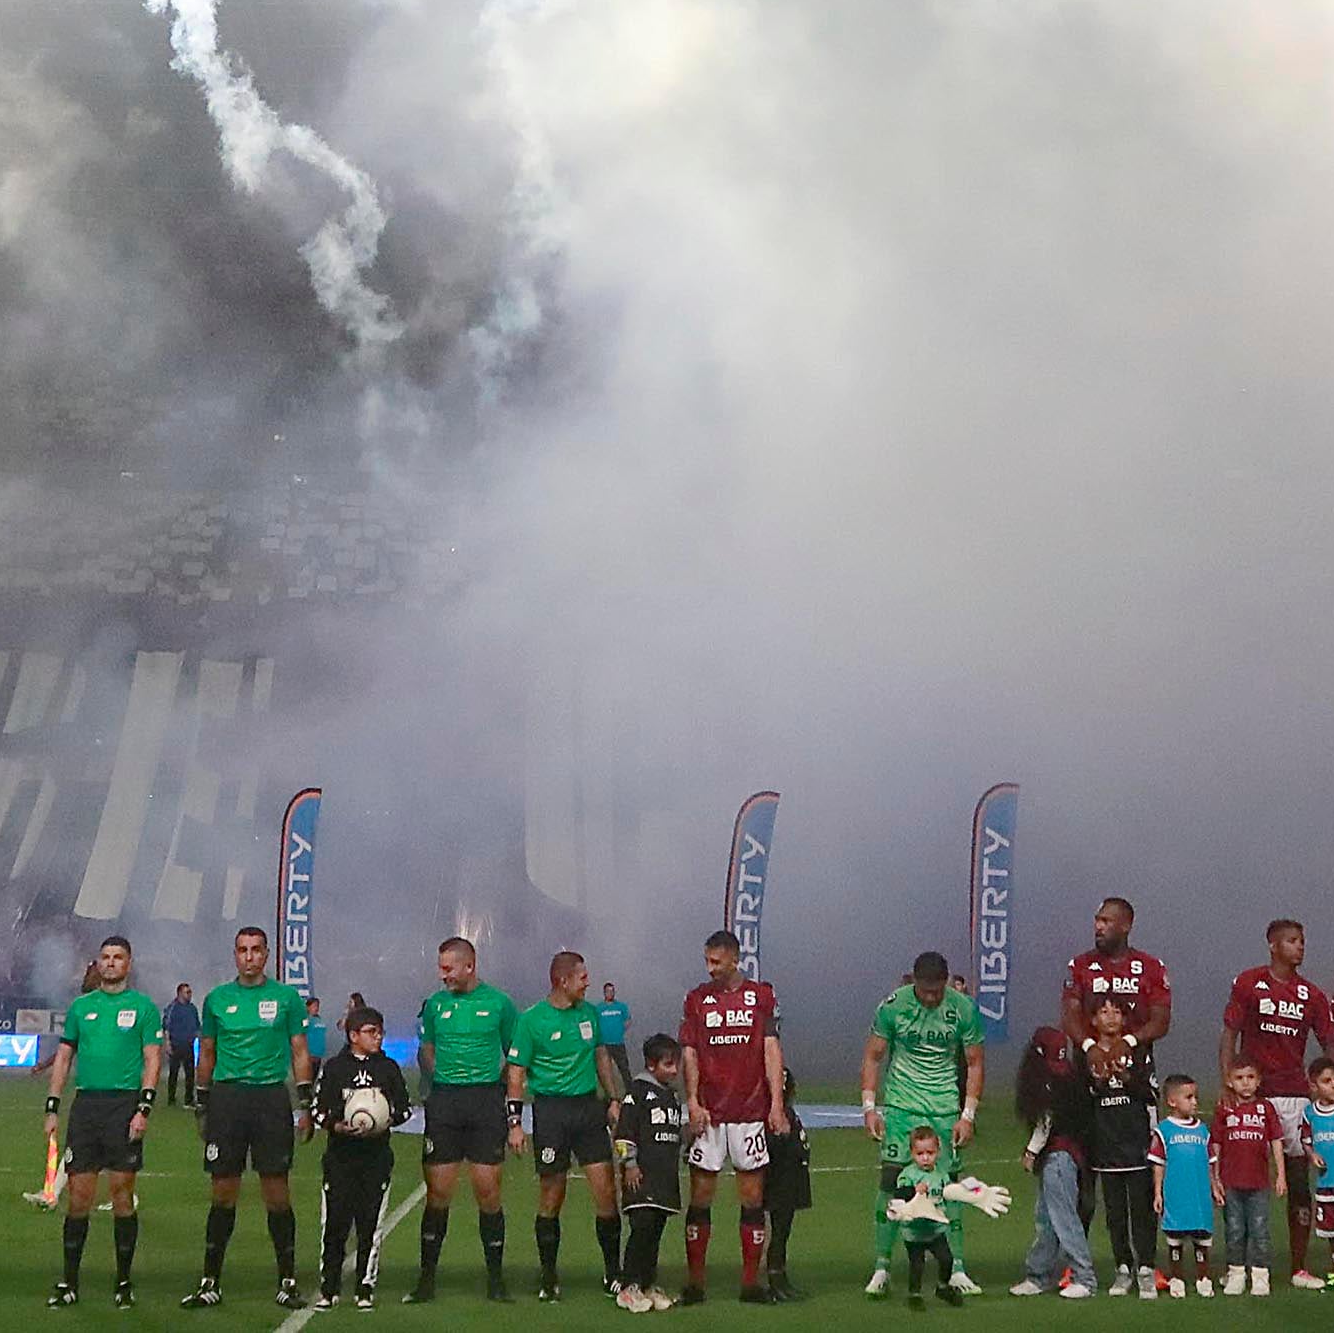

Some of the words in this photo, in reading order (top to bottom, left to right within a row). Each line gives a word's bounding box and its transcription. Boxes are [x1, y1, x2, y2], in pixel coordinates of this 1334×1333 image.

[285, 831, 312, 998] IBERTY
[734, 833, 766, 984] BERTY
[979, 826, 1010, 1021] LIBERTY
[1130, 960, 1143, 974] S
[1112, 977, 1140, 990] BAC
[743, 991, 756, 1006] S
[1297, 984, 1309, 1001] S
[1278, 1000, 1305, 1017] BAC
[726, 1010, 753, 1022] BAC
[945, 1011, 957, 1024] S
[1260, 1022, 1299, 1037] LIBERTY
[709, 1034, 750, 1045] LIBERTY
[927, 1032, 955, 1043] BAC
[1242, 1114, 1266, 1126] BAC
[1228, 1131, 1264, 1141] LIBERTY
[744, 1134, 766, 1156] 20
[887, 1143, 899, 1157] S
[692, 1148, 703, 1162] S
